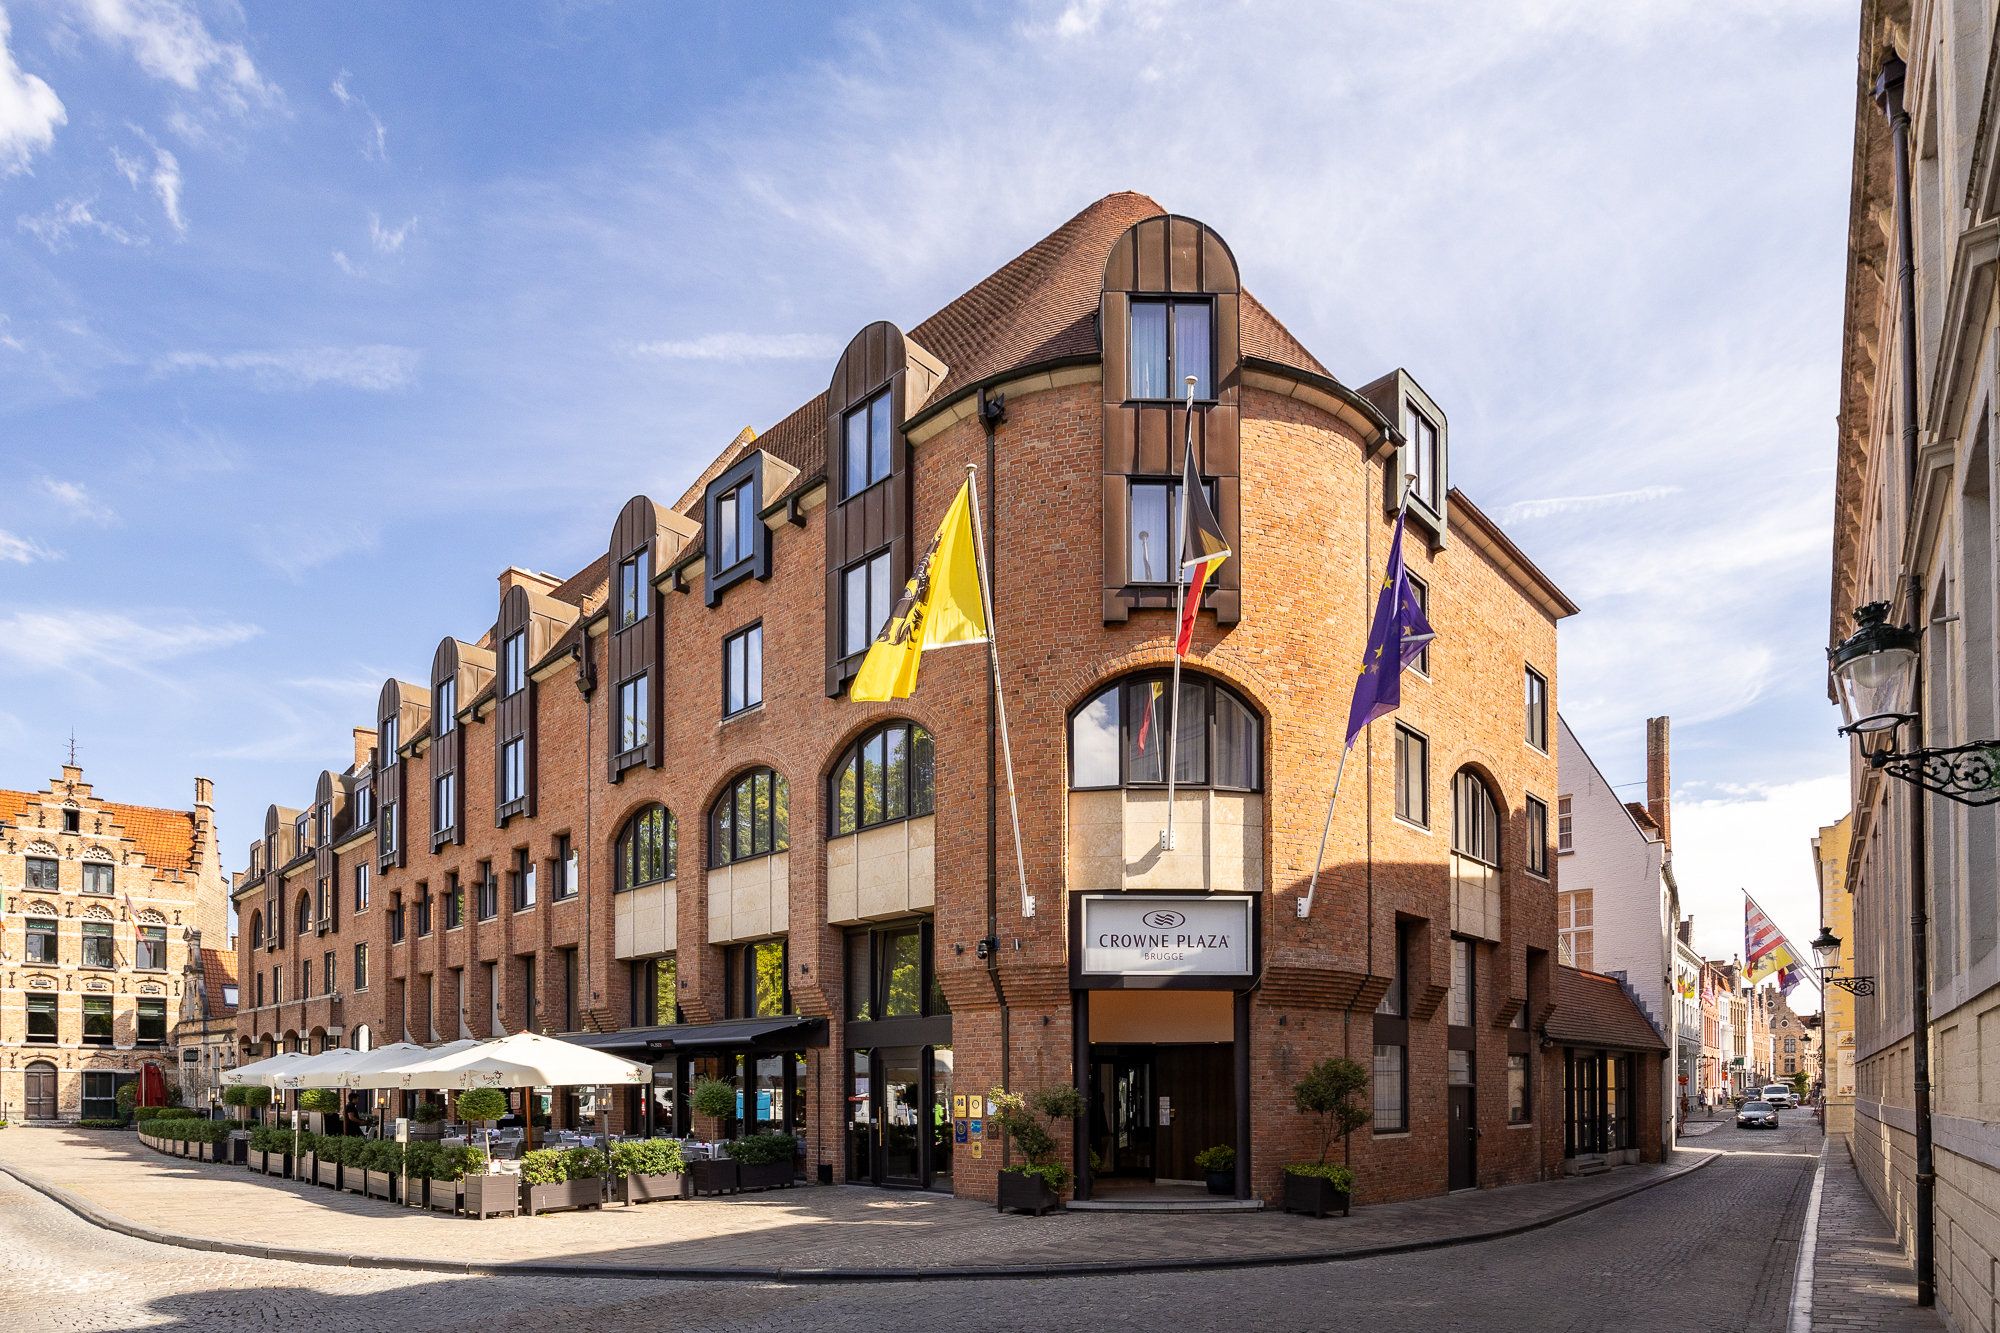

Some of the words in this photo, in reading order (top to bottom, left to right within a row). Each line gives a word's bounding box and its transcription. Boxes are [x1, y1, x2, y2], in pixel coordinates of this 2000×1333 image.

[1099, 934, 1169, 948] CROWNE
[1177, 934, 1229, 949] PLAZA
[1144, 952, 1184, 961] BRUGGE
